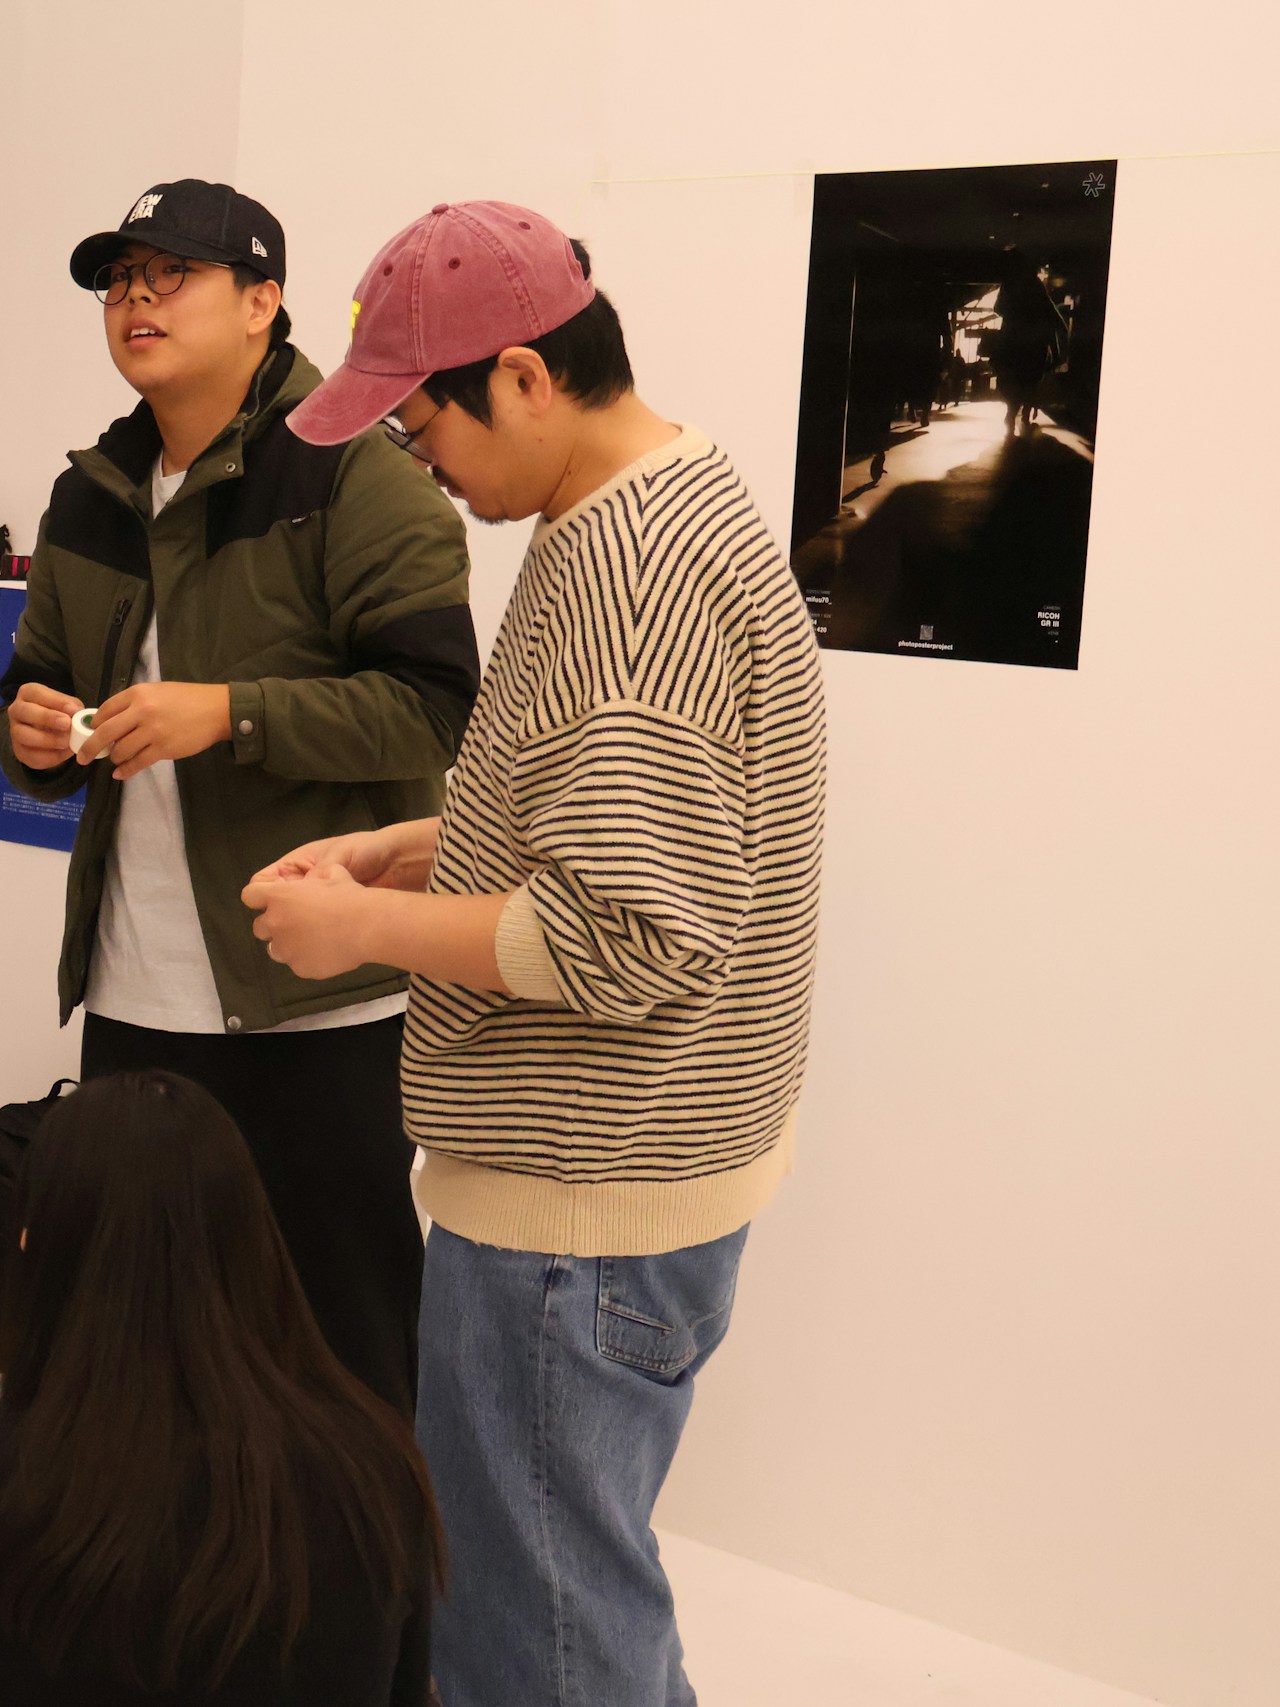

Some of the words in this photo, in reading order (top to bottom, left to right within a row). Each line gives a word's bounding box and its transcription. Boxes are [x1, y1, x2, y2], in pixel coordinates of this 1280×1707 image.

[1037, 611, 1061, 620] RICOH
[1040, 619, 1052, 628] GR
[897, 640, 954, 651] photoposterproject
